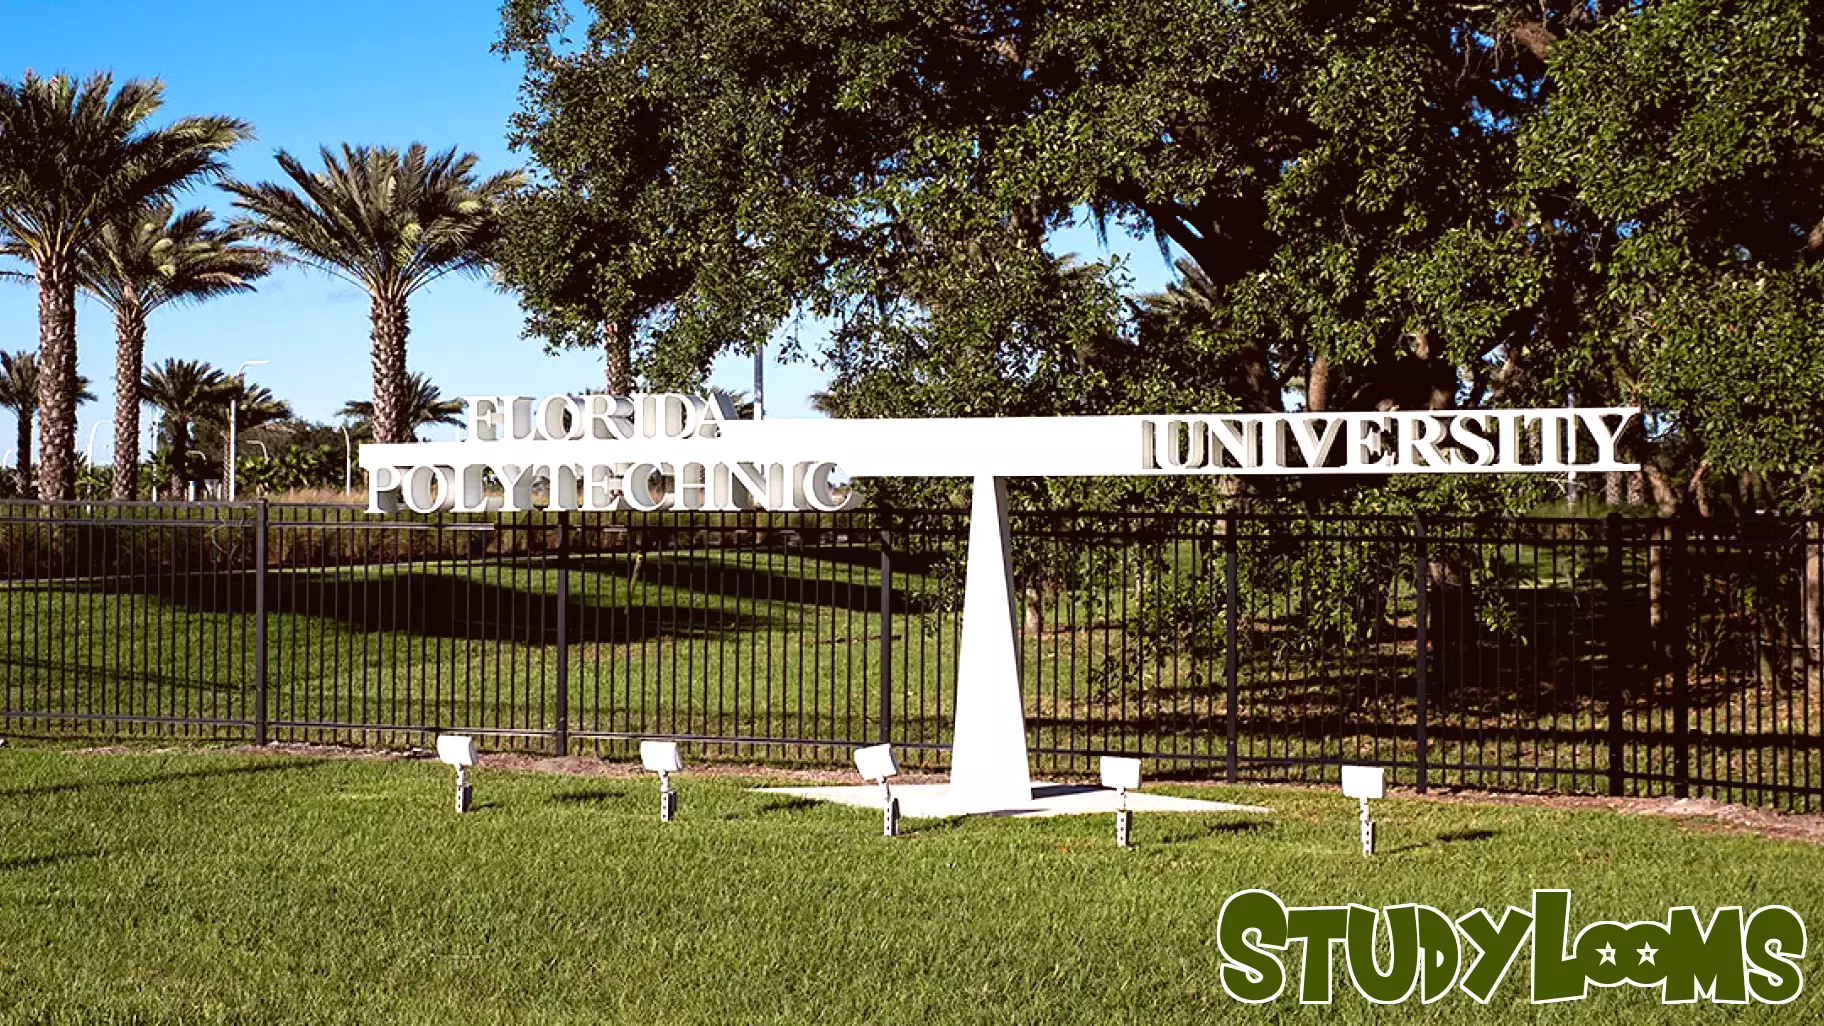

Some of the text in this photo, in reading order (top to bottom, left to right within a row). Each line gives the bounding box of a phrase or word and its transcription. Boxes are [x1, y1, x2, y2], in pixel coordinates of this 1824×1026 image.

[465, 394, 732, 442] FLORIDA
[1148, 408, 1640, 471] UNIVERSITY
[364, 462, 855, 513] POLYTECHNIC
